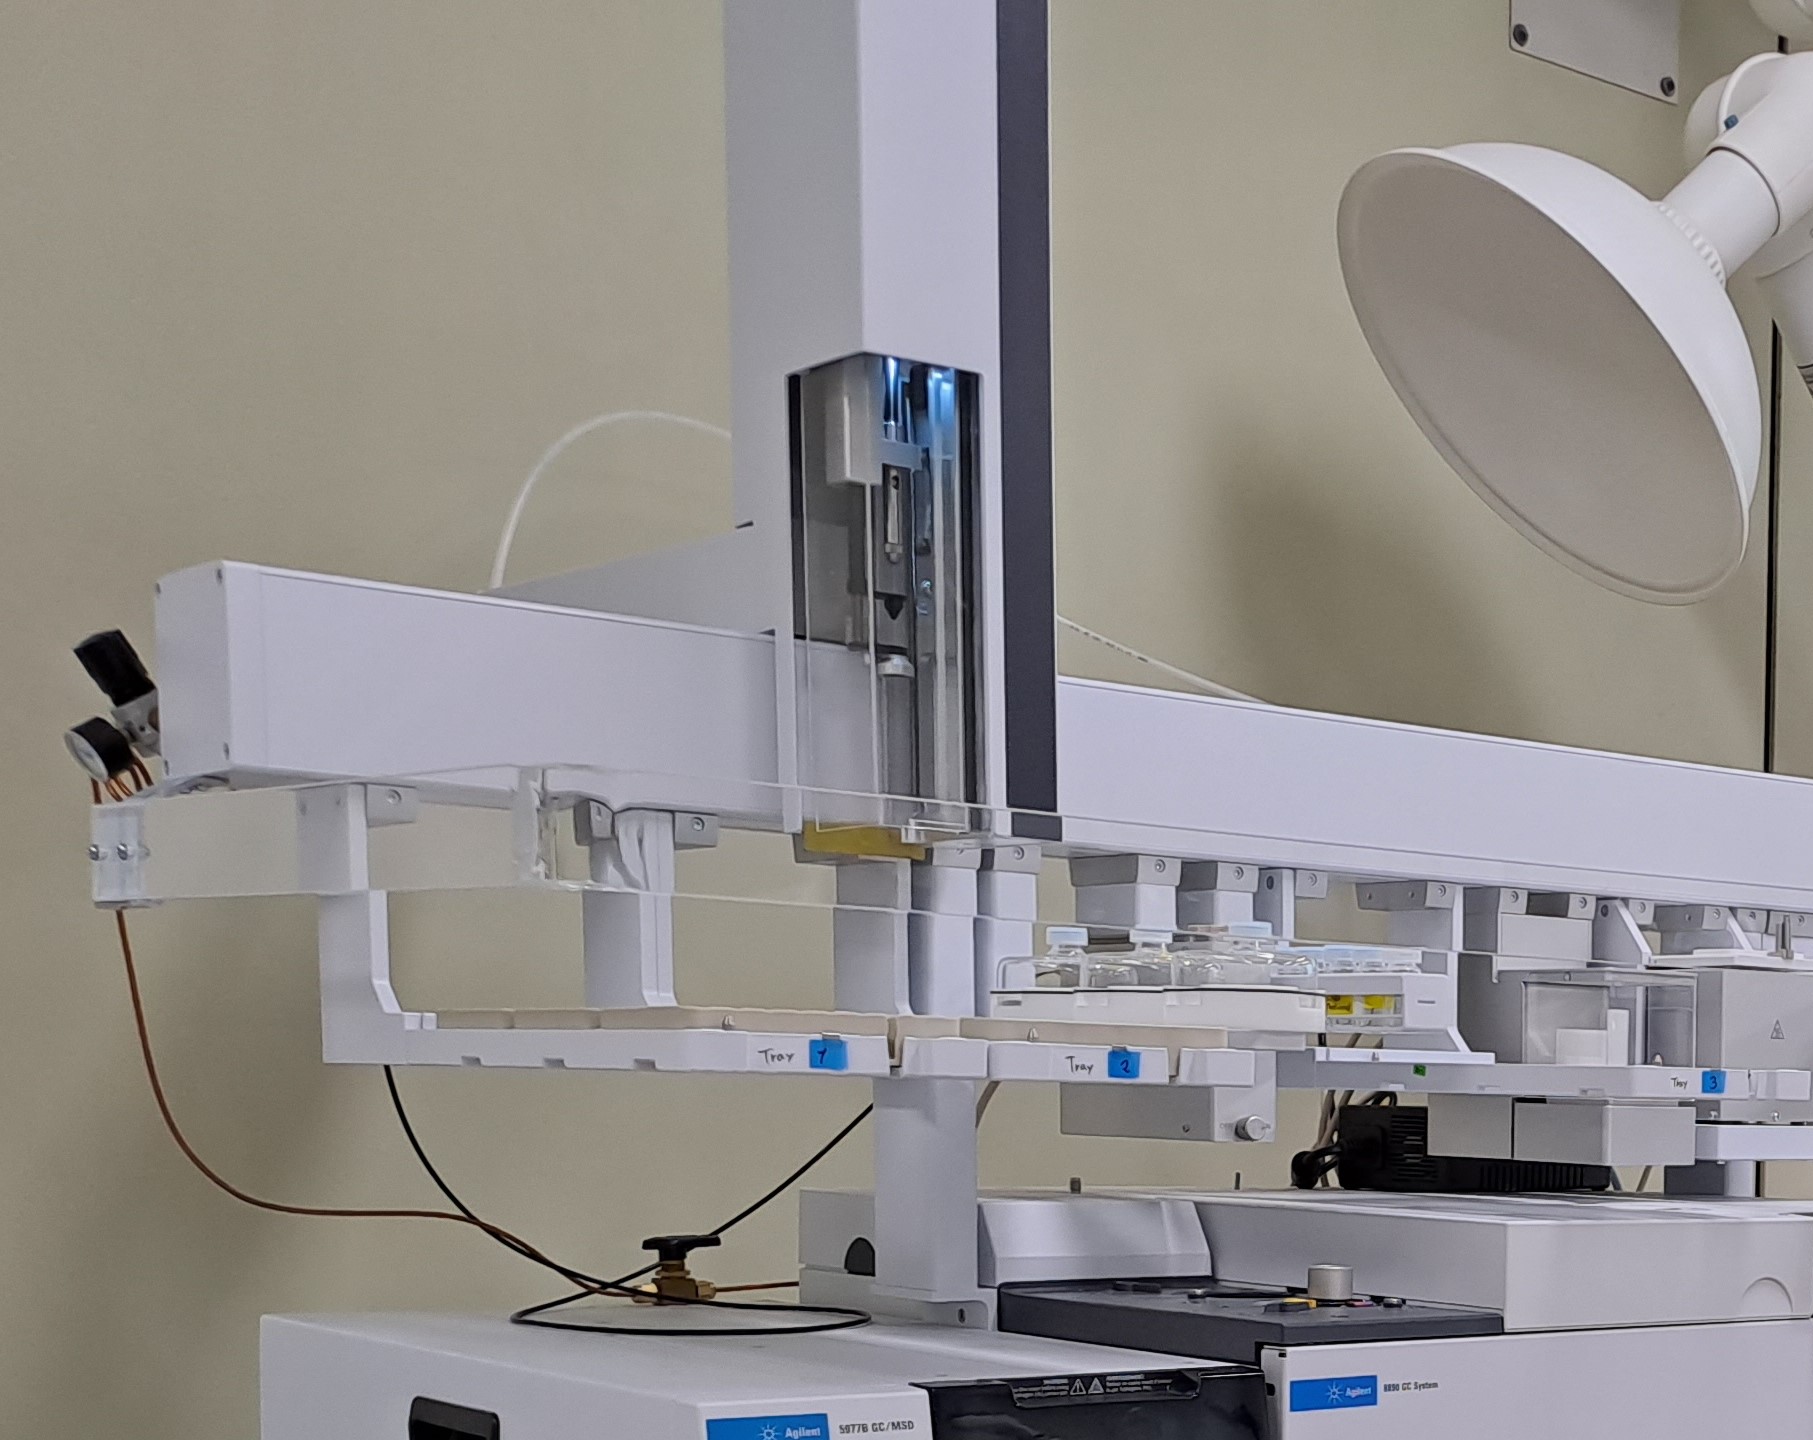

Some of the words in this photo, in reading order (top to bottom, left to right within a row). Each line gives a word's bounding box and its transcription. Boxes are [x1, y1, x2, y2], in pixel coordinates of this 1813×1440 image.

[758, 1048, 796, 1065] Tray
[1065, 1055, 1094, 1075] Tray
[1120, 1059, 1132, 1074] 2
[1709, 1075, 1719, 1090] 3
[1402, 1382, 1412, 1391] GC
[1414, 1381, 1439, 1392] System
[785, 1427, 821, 1440] Agilent
[871, 1420, 915, 1433] GC/MSD
